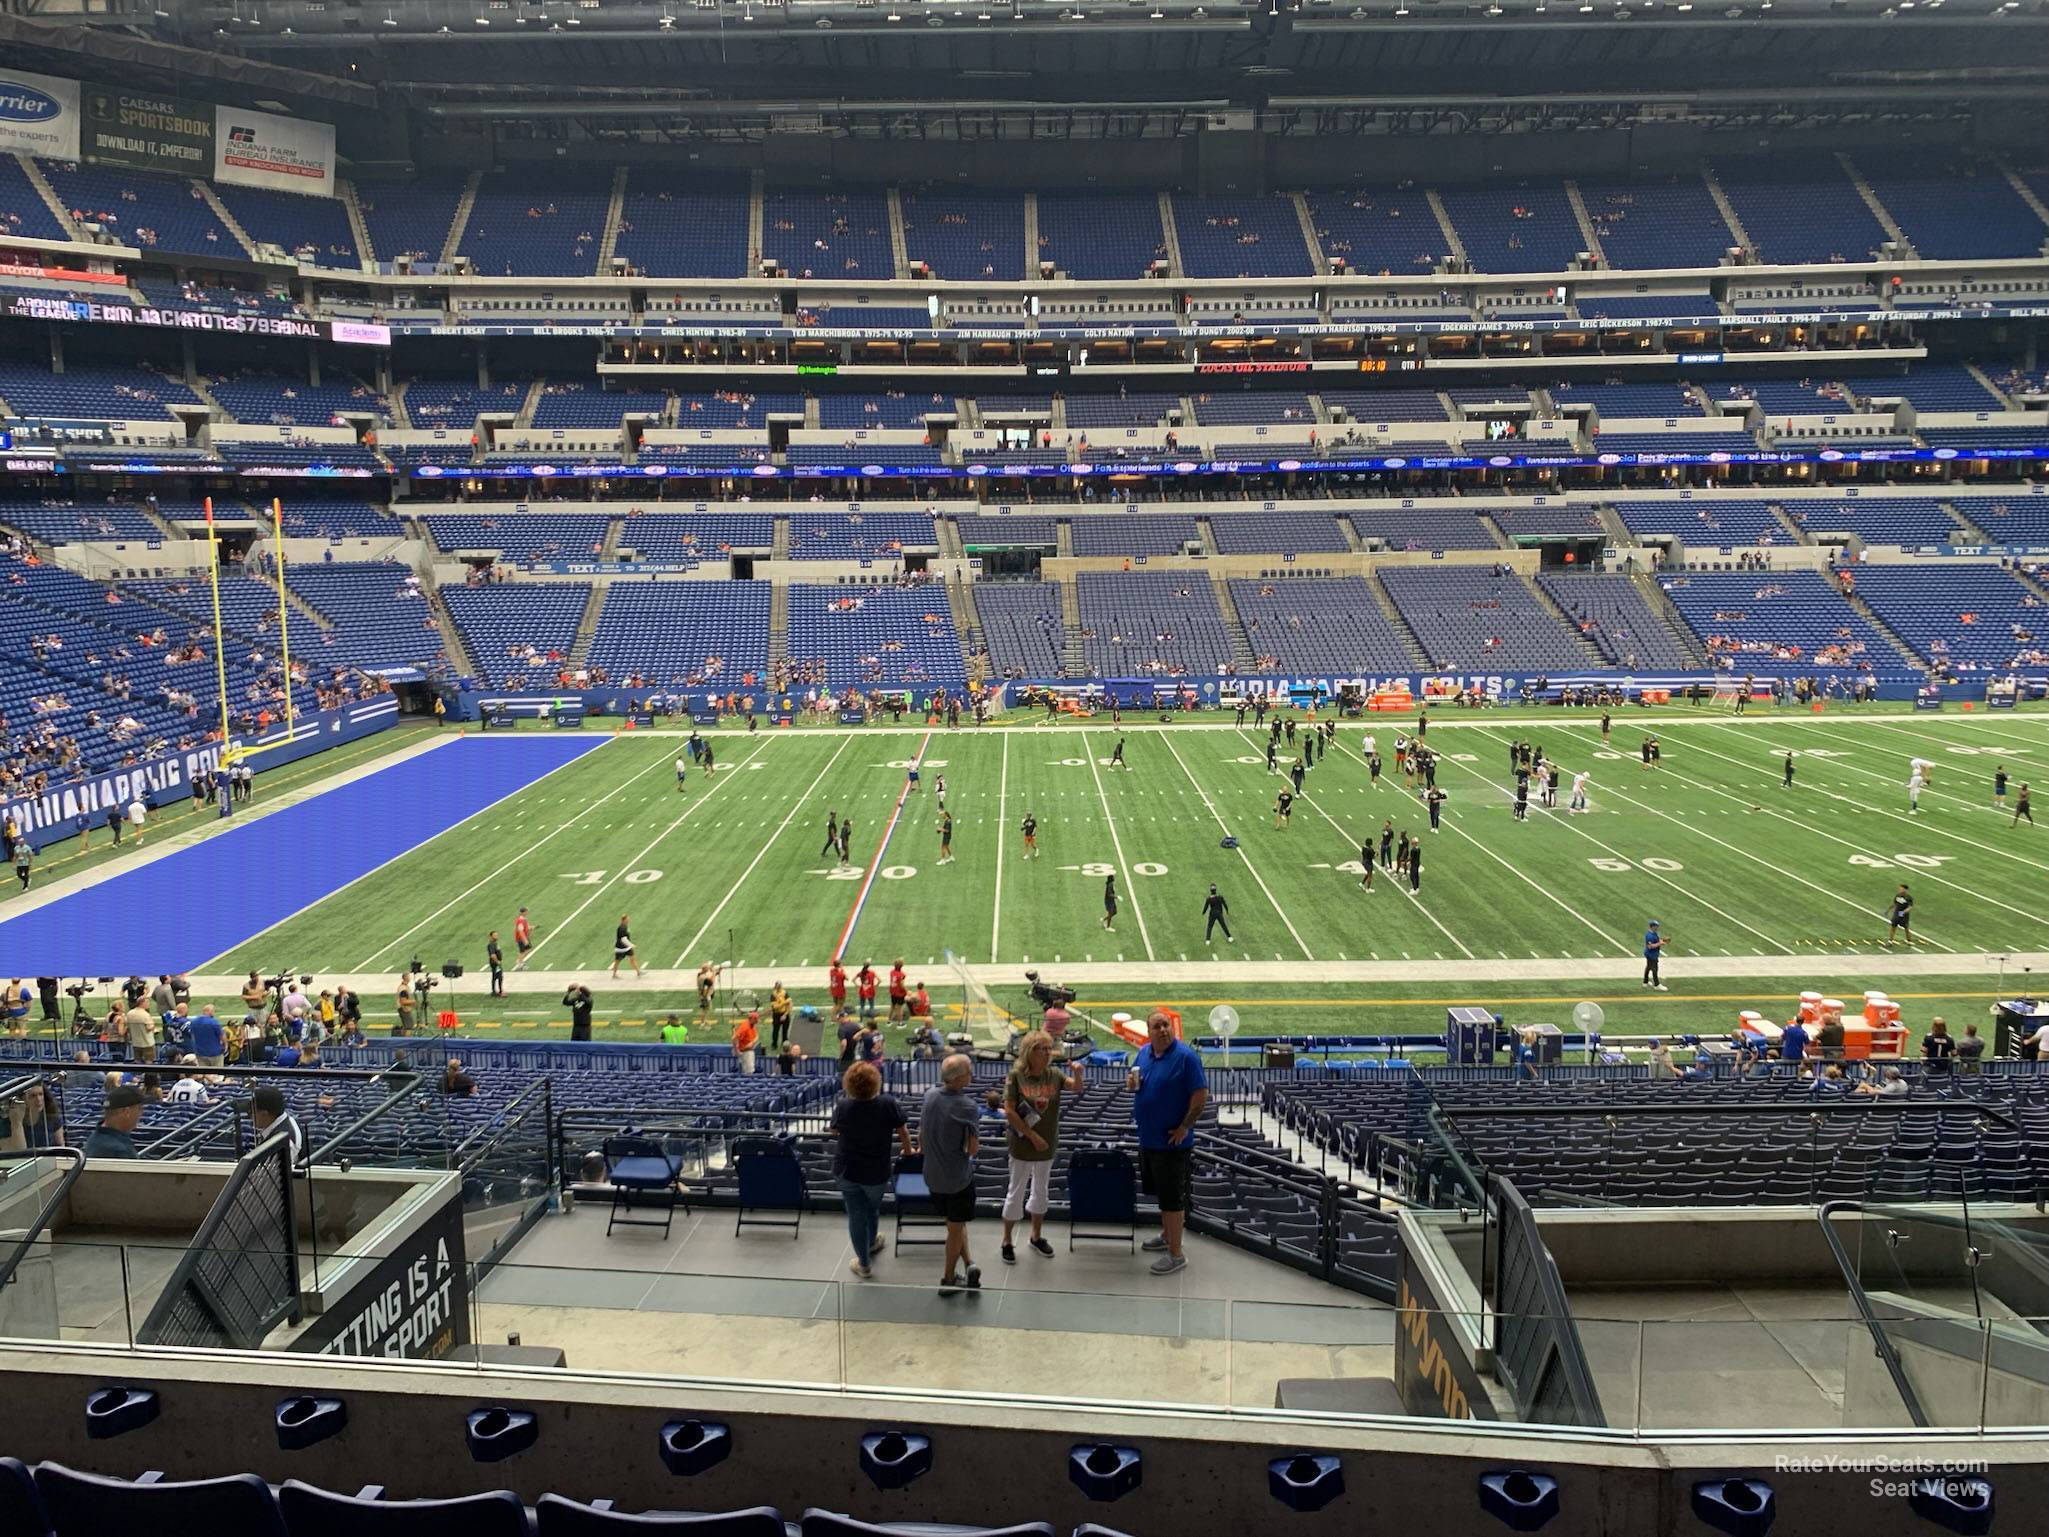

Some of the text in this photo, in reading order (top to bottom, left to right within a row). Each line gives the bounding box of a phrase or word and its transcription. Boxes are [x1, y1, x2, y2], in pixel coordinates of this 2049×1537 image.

[119, 97, 174, 114] CAESARS
[119, 109, 211, 137] SPORTSBOOK
[19, 131, 59, 143] experts
[96, 133, 145, 152] DOWNLOAD
[227, 140, 297, 157] INDIANA FARM
[225, 147, 325, 168] BUREAU INSURANCE
[1, 265, 45, 277] TOYOTA
[16, 297, 69, 309] AROUND
[8, 306, 30, 316] THE
[1868, 312, 1887, 320] JEFF
[1888, 311, 1928, 319] SATURDAY
[1478, 323, 1502, 331] JAMES
[1580, 321, 1598, 329] ERIC
[1600, 320, 1641, 328] DICKERSON
[533, 328, 551, 336] BILL
[552, 328, 582, 336] BROOKS
[661, 328, 684, 336] CHRIS
[686, 328, 715, 336] HINTON
[792, 330, 807, 338] TED
[808, 330, 861, 338] MARCHIBRODA
[957, 331, 971, 339] JIM
[972, 331, 1011, 339] HARBAUGH
[1108, 329, 1134, 337] NATION
[1178, 329, 1198, 337] TONY
[1199, 329, 1224, 337] DUNGY
[1298, 327, 1326, 335] MARVIN
[1328, 326, 1366, 334] HARRISON
[1200, 363, 1308, 373] LUCAS OIL STADIUM
[1401, 361, 1415, 370] QTR
[1953, 546, 1983, 555] TEXT
[567, 564, 596, 573] TEXT
[1587, 857, 1684, 872] 50
[1848, 853, 1942, 868] 40
[826, 865, 917, 880] 20
[1081, 862, 1168, 877] 30
[575, 869, 664, 885] 10
[408, 1254, 429, 1306] IS
[436, 1237, 450, 1280] A
[384, 1277, 452, 1358] SPORT
